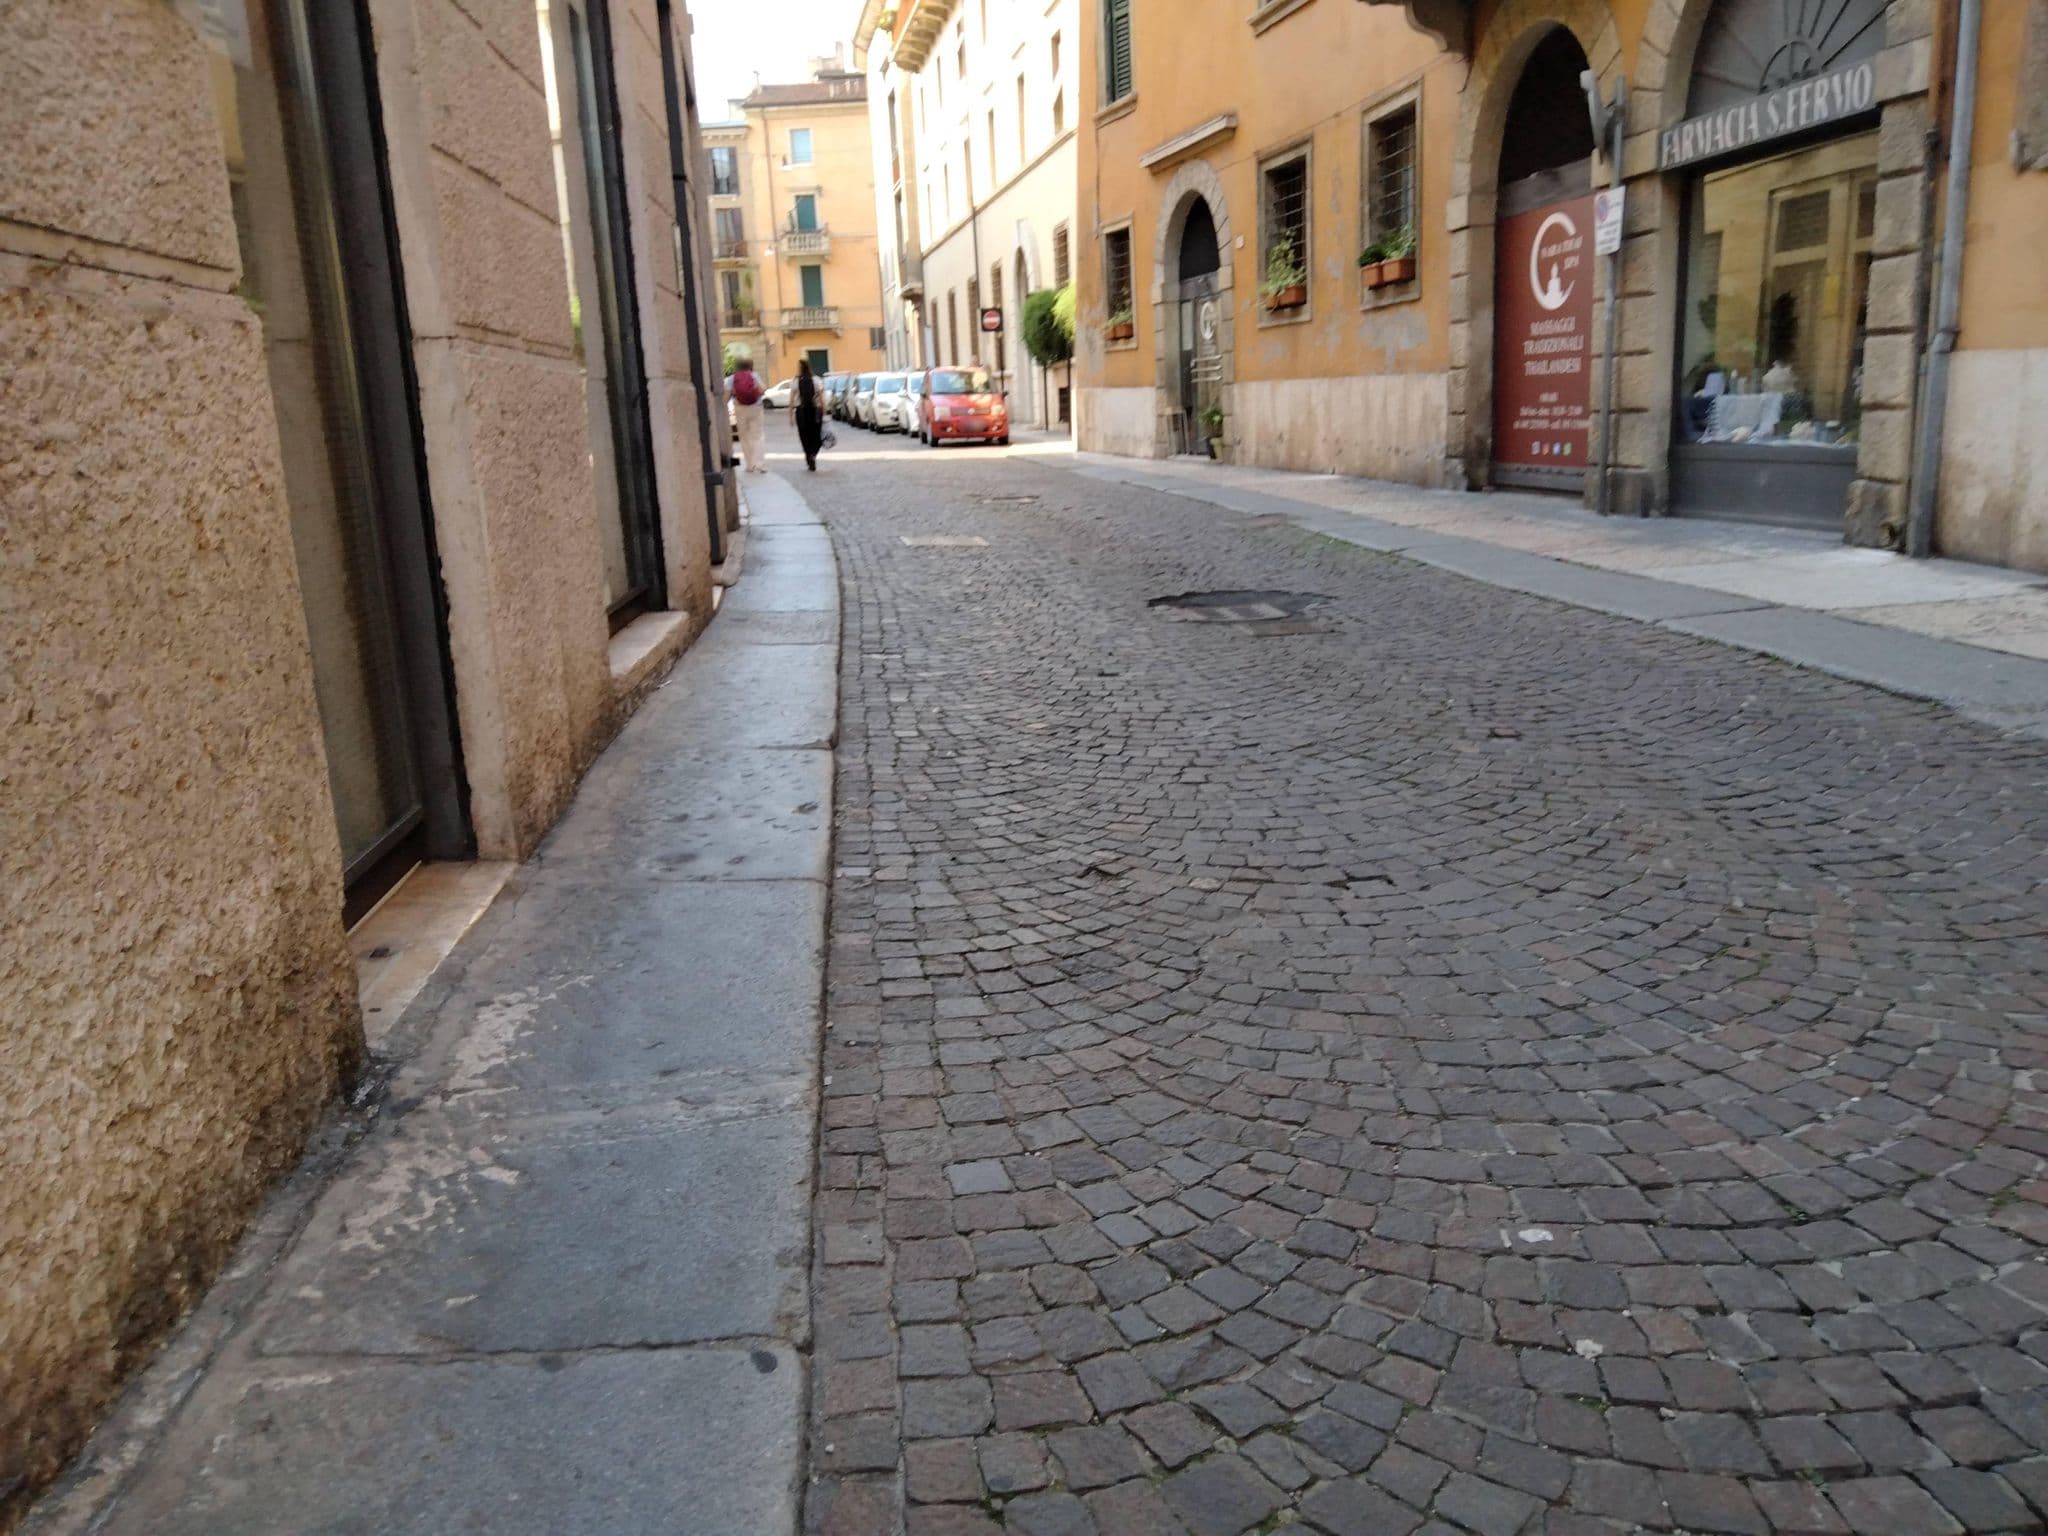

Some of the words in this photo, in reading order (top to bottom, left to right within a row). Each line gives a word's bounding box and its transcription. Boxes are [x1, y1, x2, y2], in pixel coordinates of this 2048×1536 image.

[1661, 101, 1762, 168] FARMACIA
[1530, 316, 1576, 336] MASSAGGI
[1522, 334, 1584, 355] TRADIZIONALI
